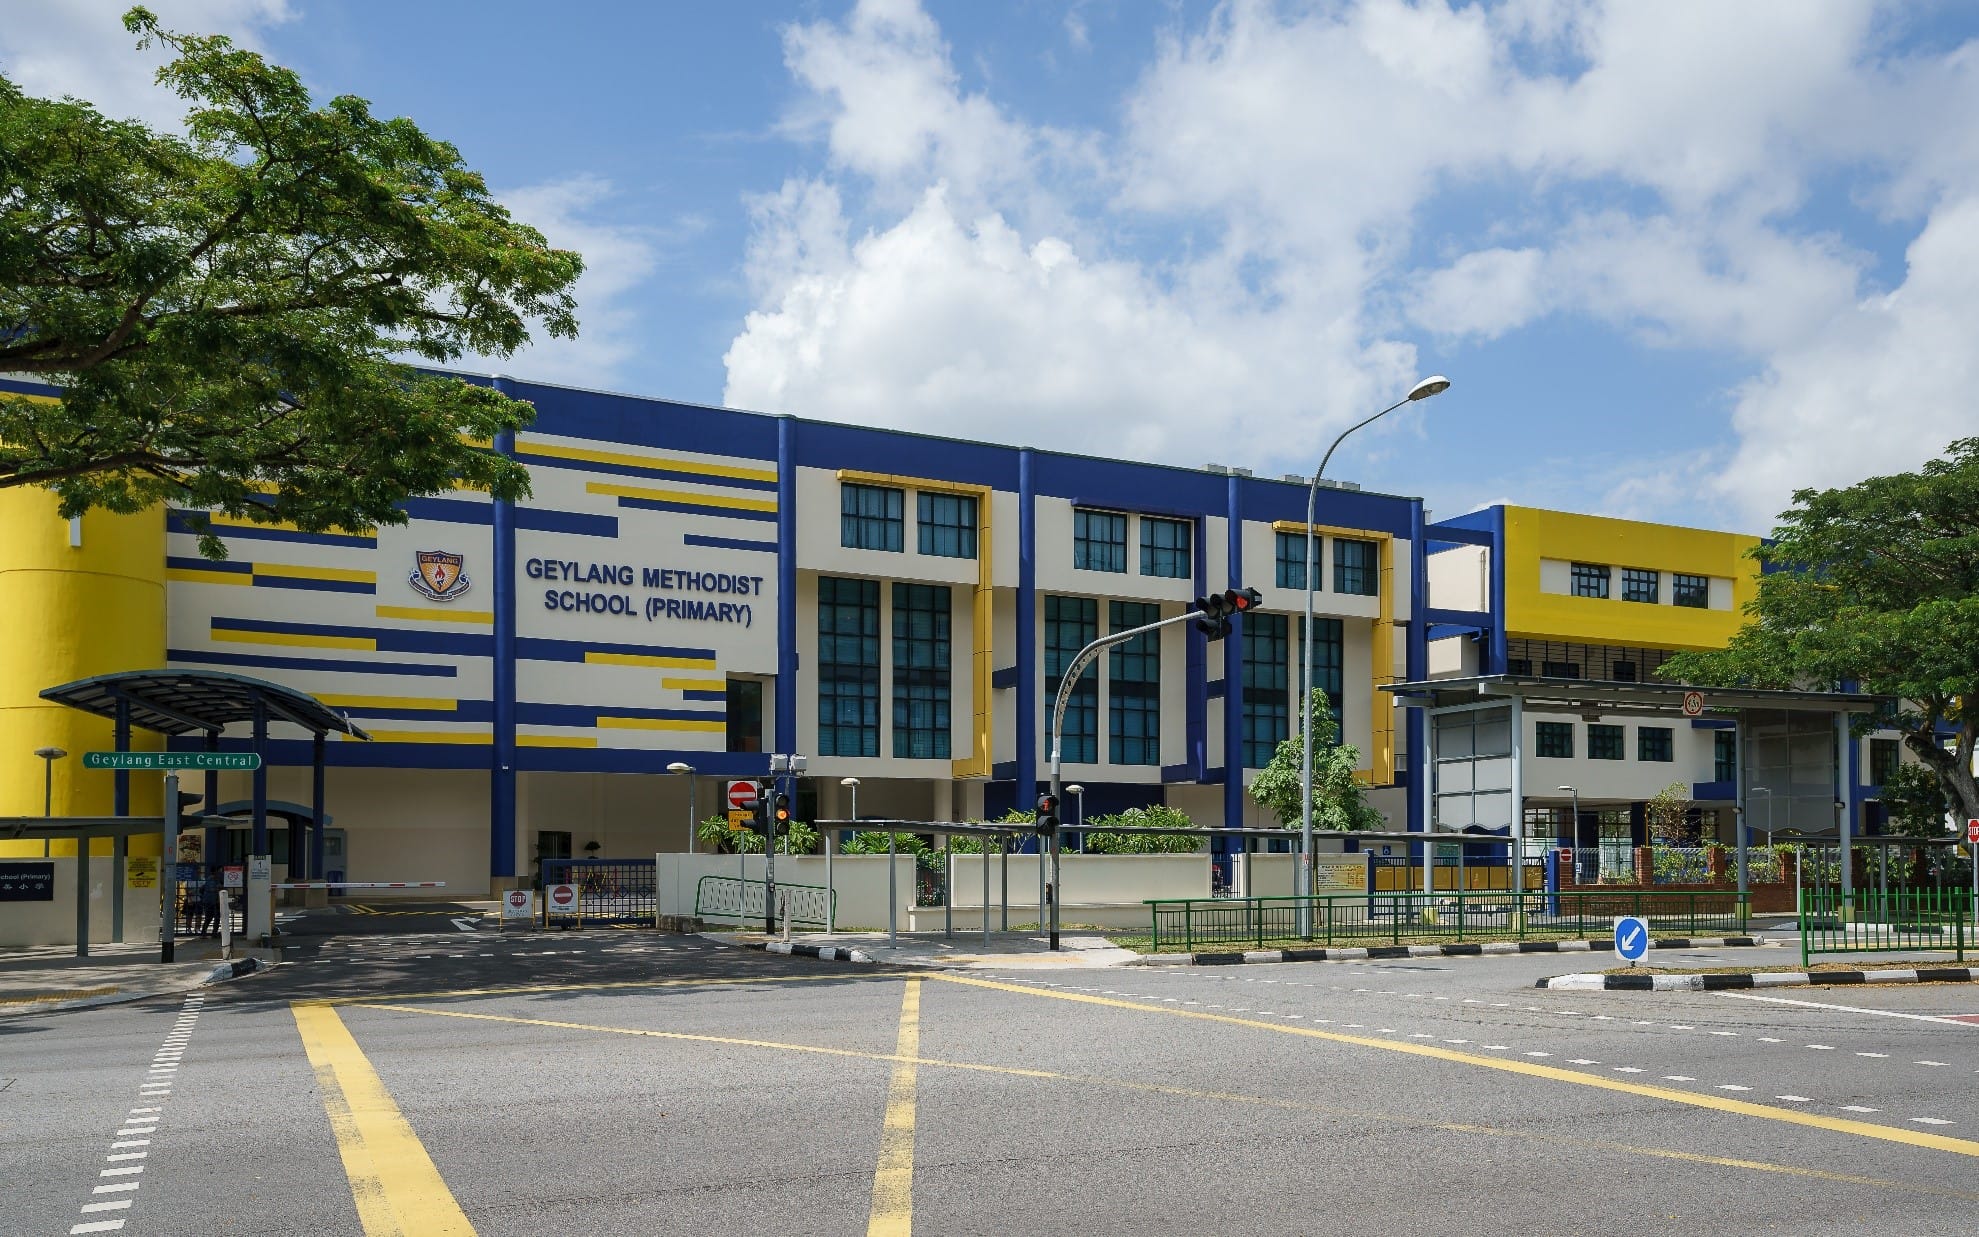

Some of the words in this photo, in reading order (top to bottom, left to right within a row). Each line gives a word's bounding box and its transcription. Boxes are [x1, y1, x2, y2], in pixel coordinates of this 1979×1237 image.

[421, 555, 458, 565] GEYLANG
[526, 558, 634, 586] GEYLANG
[642, 567, 764, 596] METHODIST
[544, 589, 638, 616] SCHOOL
[645, 597, 752, 628] (PRIMARY)
[91, 754, 152, 767] Geylang
[158, 754, 190, 765] East
[196, 754, 252, 766] Central
[20, 873, 51, 881] (Primary)
[510, 895, 526, 903] STOP
